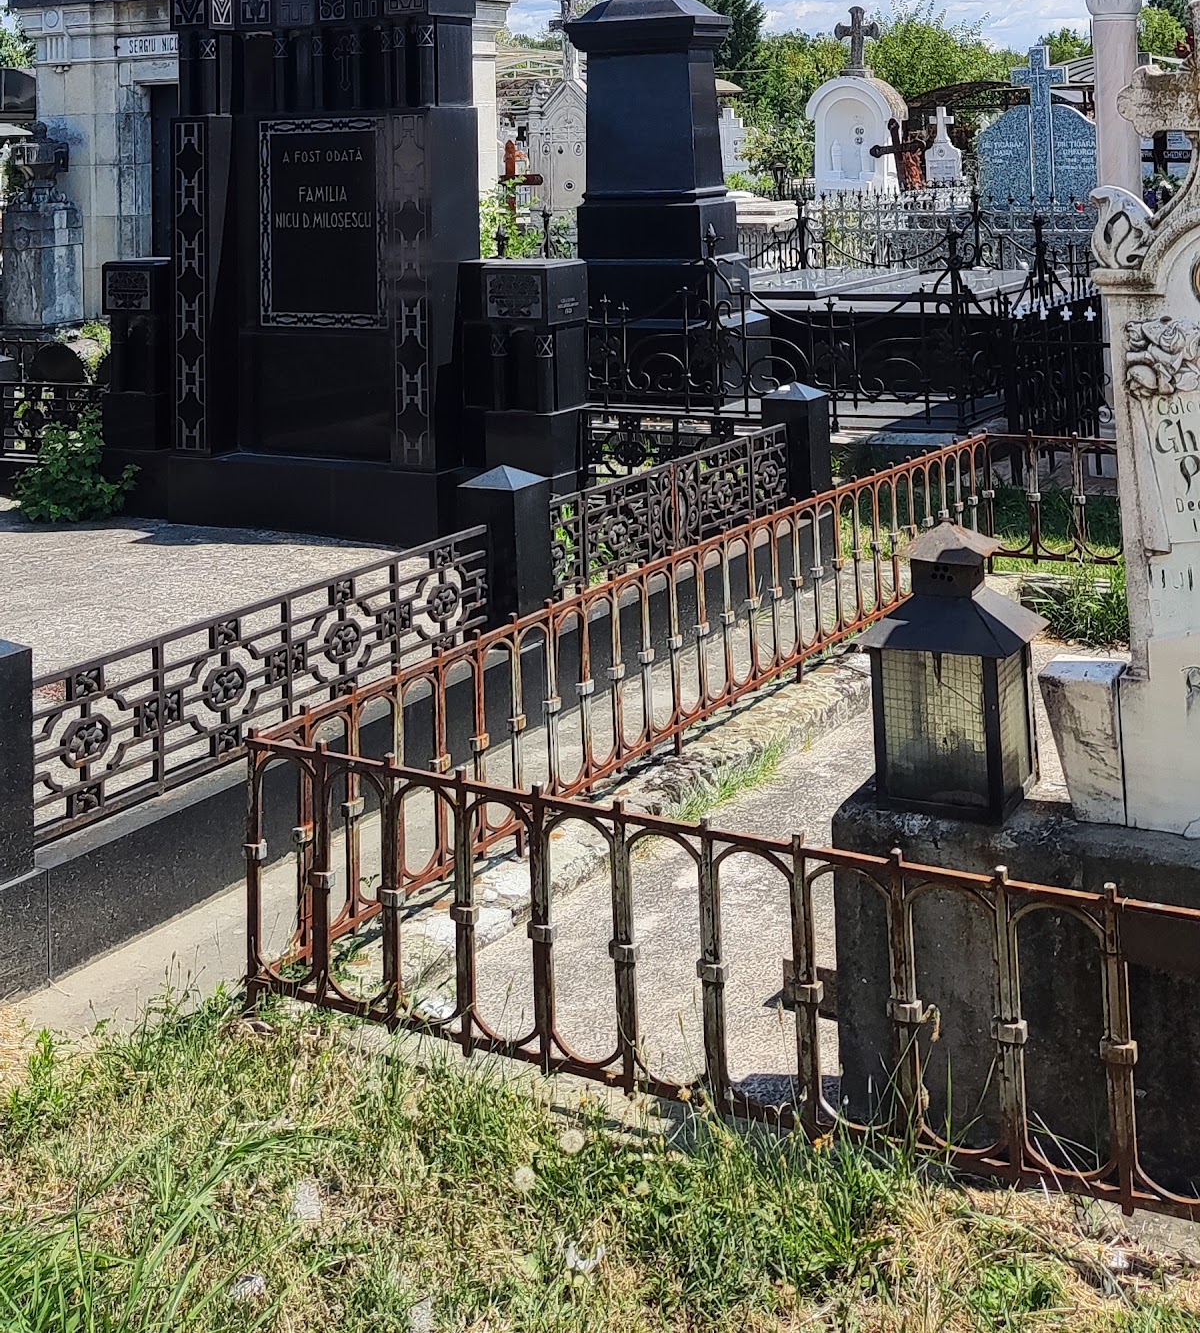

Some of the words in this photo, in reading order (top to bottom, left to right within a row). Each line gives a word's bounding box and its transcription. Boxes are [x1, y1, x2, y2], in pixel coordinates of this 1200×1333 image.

[129, 38, 156, 54] SERGIU
[282, 151, 290, 163] A
[294, 150, 321, 163] FOST
[326, 147, 363, 163] ODATĂ
[298, 185, 348, 203] FAMILIA
[275, 212, 299, 229] NICU
